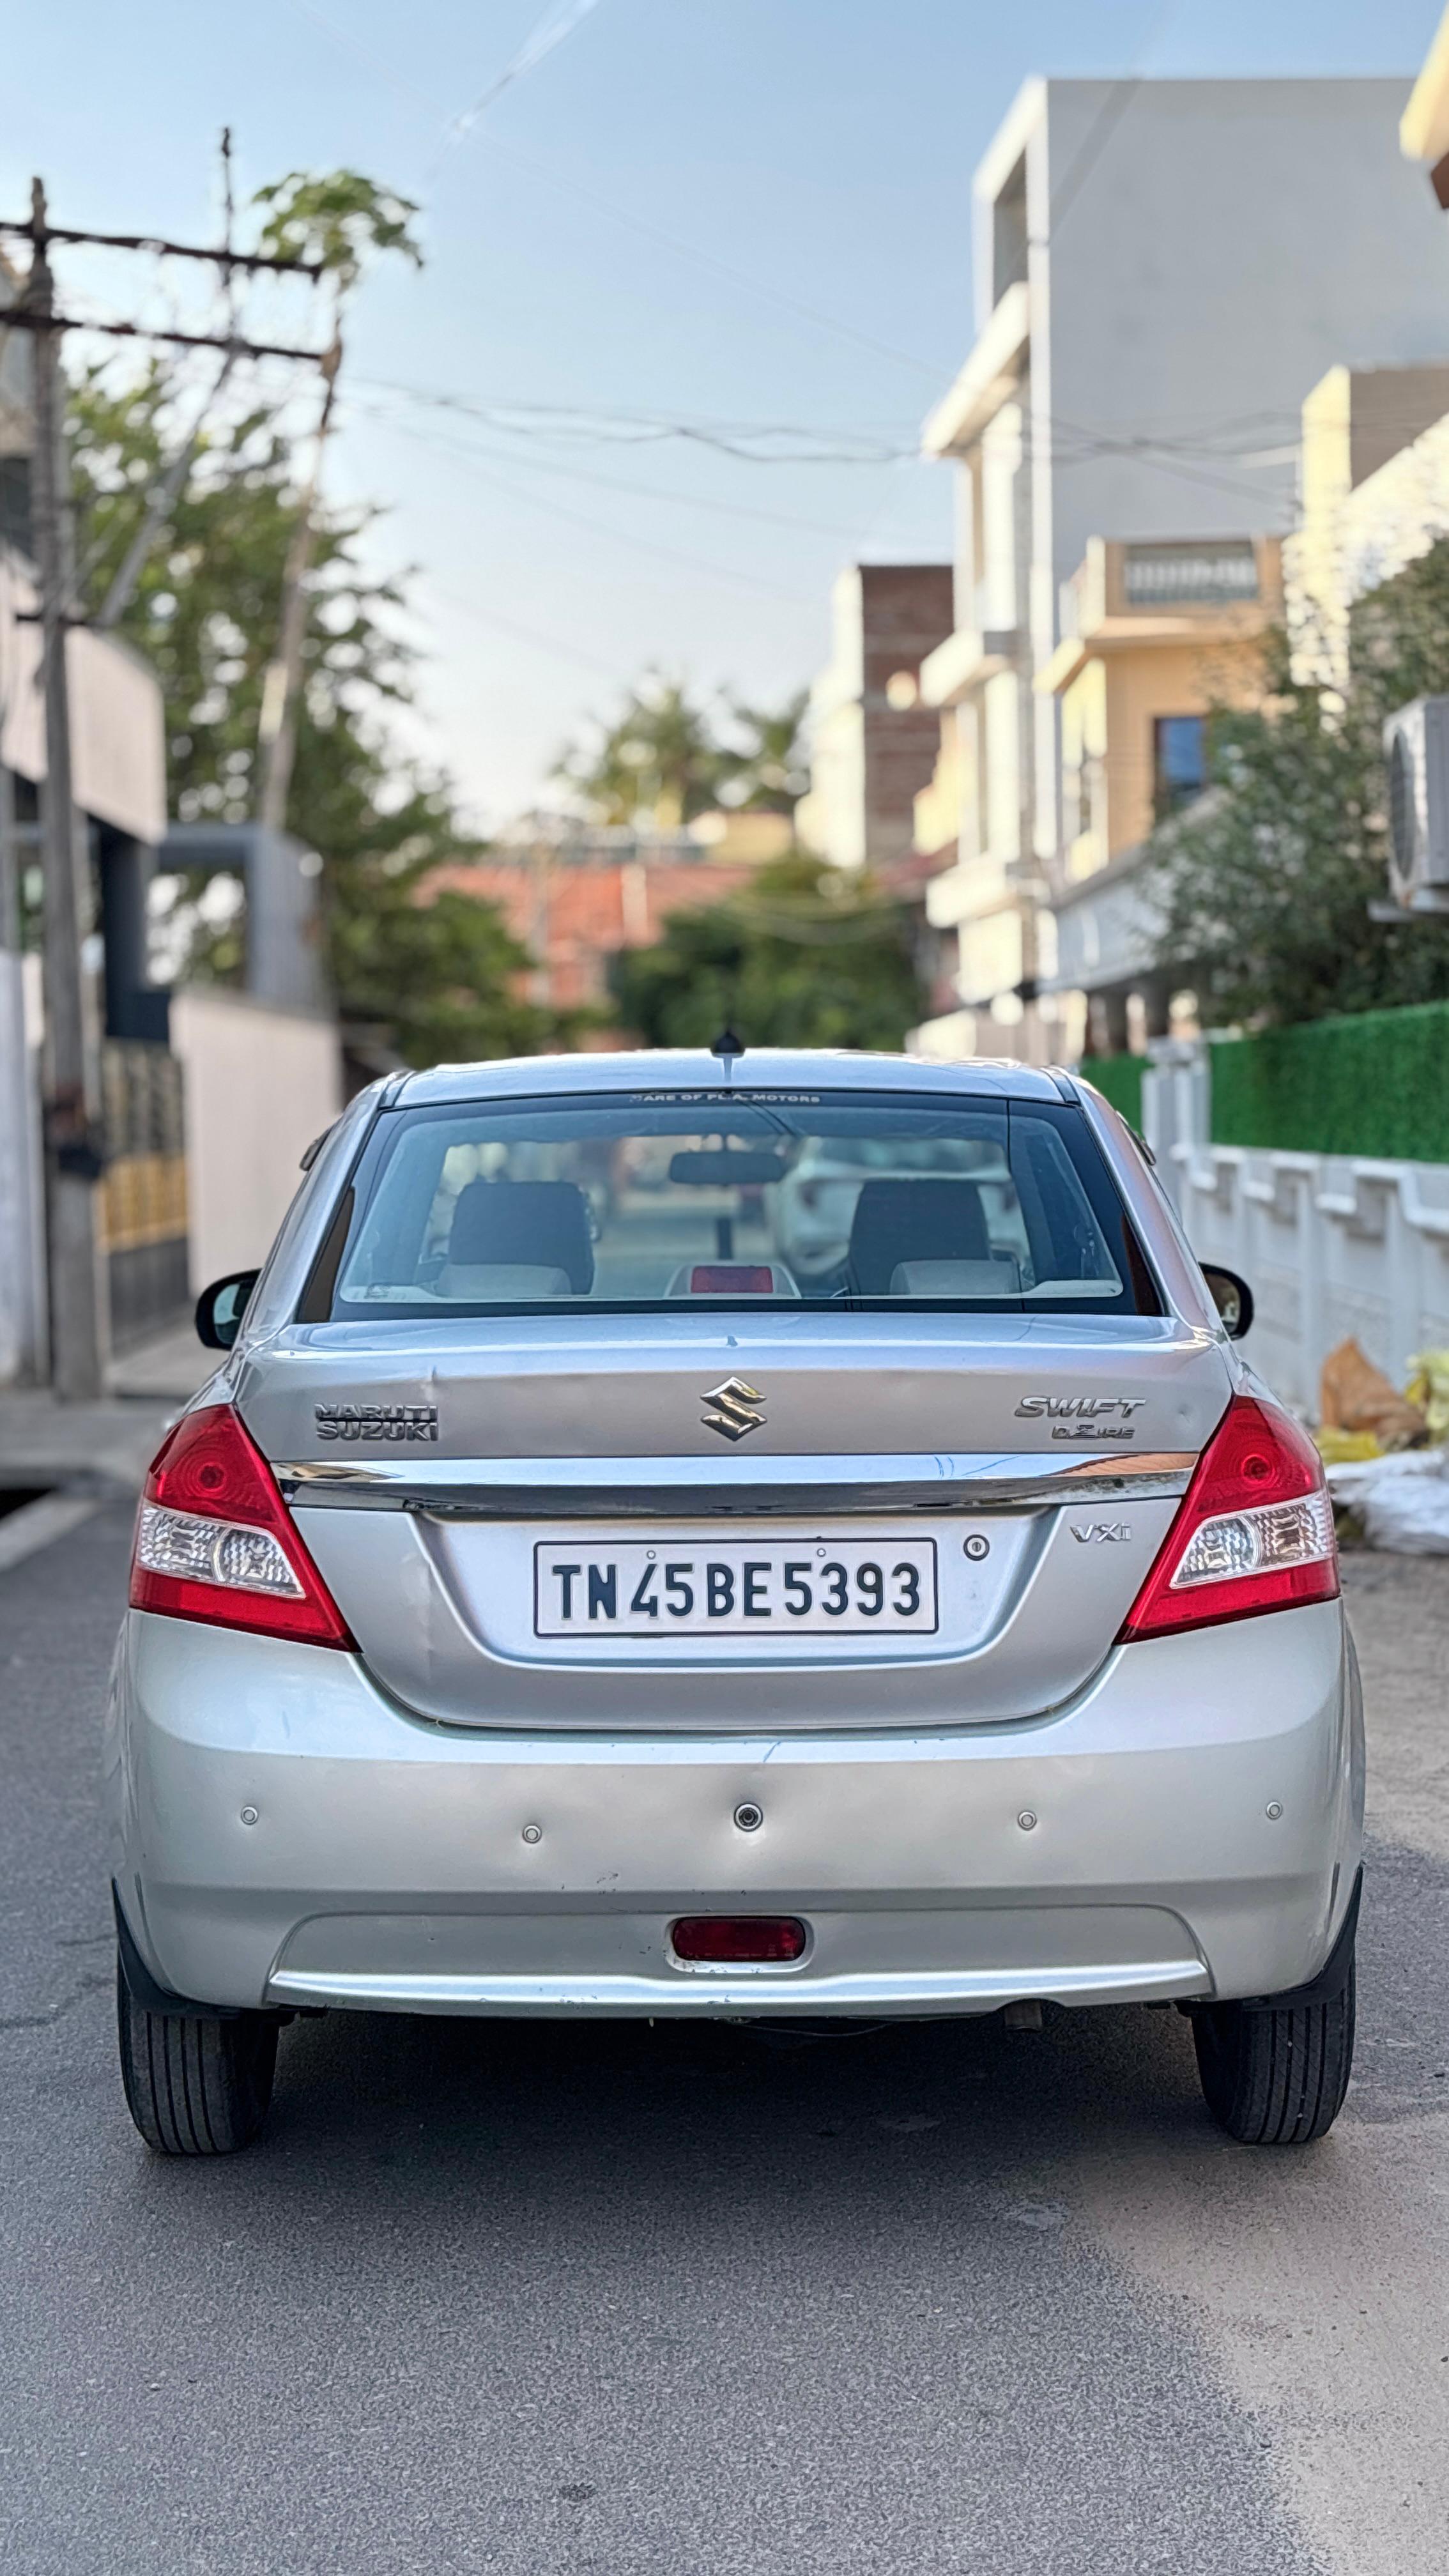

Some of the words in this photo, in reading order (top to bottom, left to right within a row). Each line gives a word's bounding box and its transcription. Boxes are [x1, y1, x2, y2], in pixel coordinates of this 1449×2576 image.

[751, 1094, 820, 1103] MOTORS
[314, 1404, 438, 1420] MARUTI
[1014, 1396, 1147, 1418] SWIFT
[316, 1420, 439, 1441] SUZUKI
